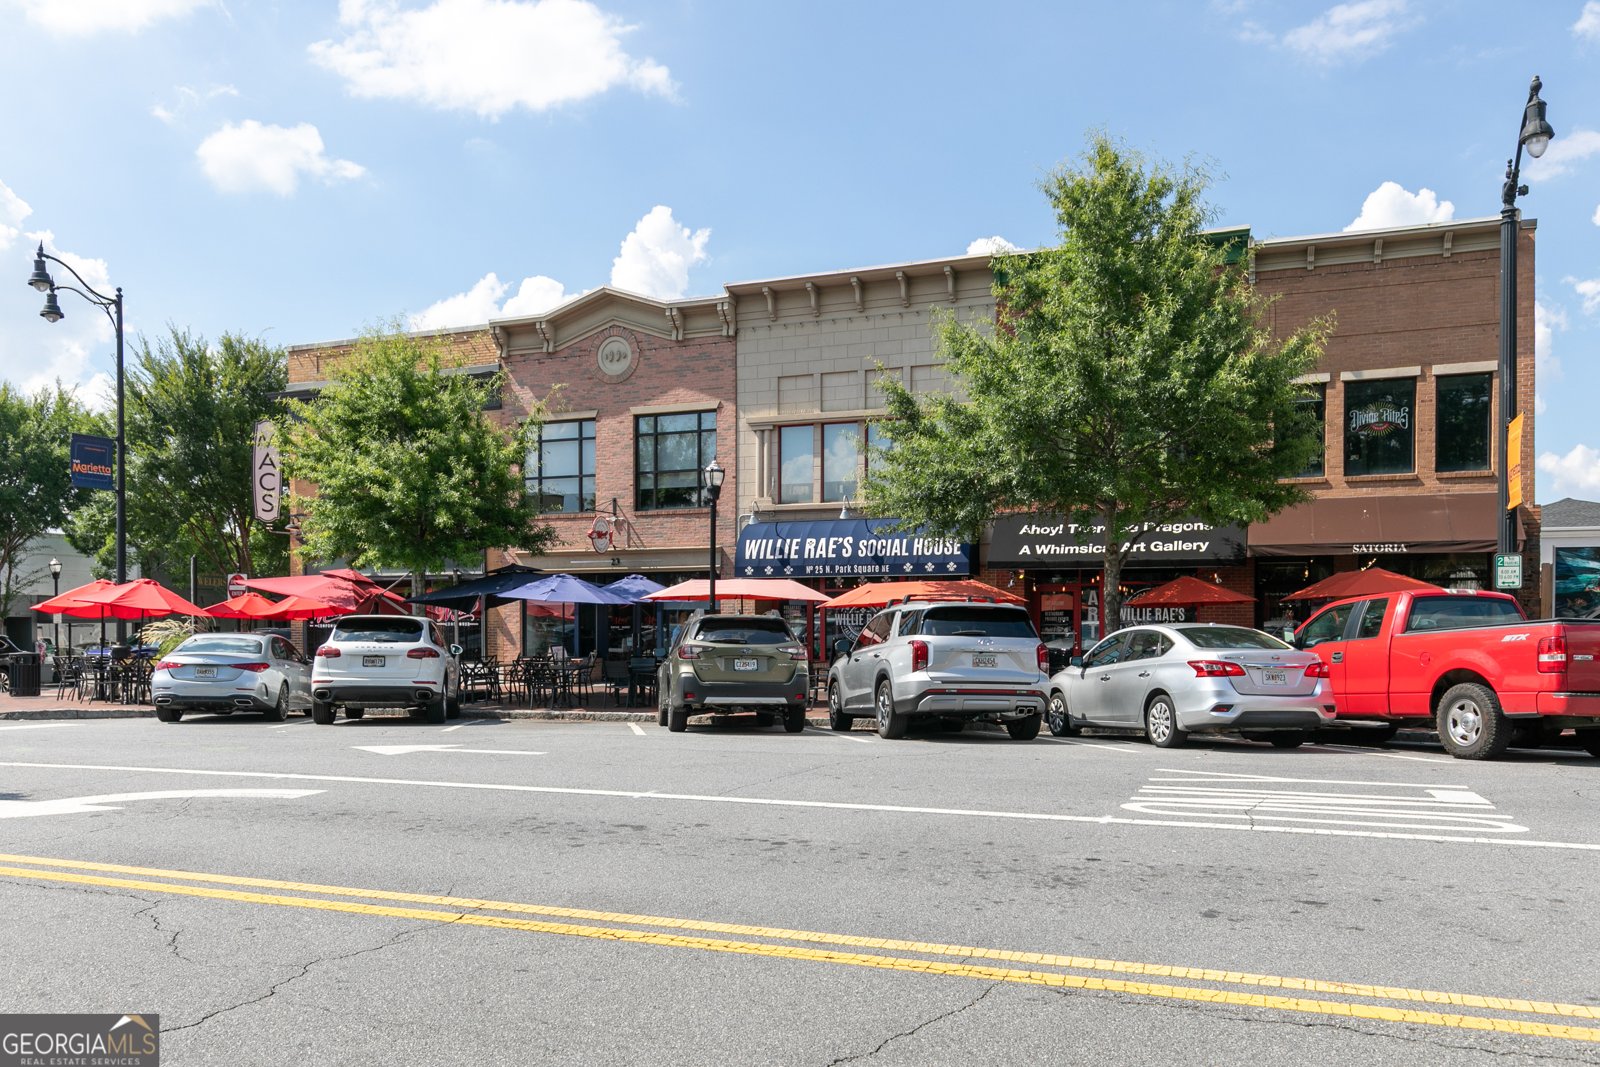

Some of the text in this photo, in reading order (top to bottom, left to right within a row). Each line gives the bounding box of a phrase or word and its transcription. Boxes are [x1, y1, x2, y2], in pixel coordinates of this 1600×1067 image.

[72, 463, 112, 474] Marietta
[1019, 524, 1064, 536] Ahoy!
[744, 536, 961, 560] WILLIE RAE'S SOCIAL HOUSE
[1018, 540, 1210, 555] A Whimsic Art Gallery
[1352, 544, 1408, 552] SATORIA
[1498, 558, 1504, 566] 2
[815, 566, 824, 574] 25
[826, 566, 833, 574] N.
[835, 564, 852, 574] Park
[854, 564, 880, 574] Square
[882, 564, 890, 572] NE
[1088, 590, 1098, 638] ART
[1155, 607, 1185, 620] RAE'S
[834, 614, 864, 626] WILLIE
